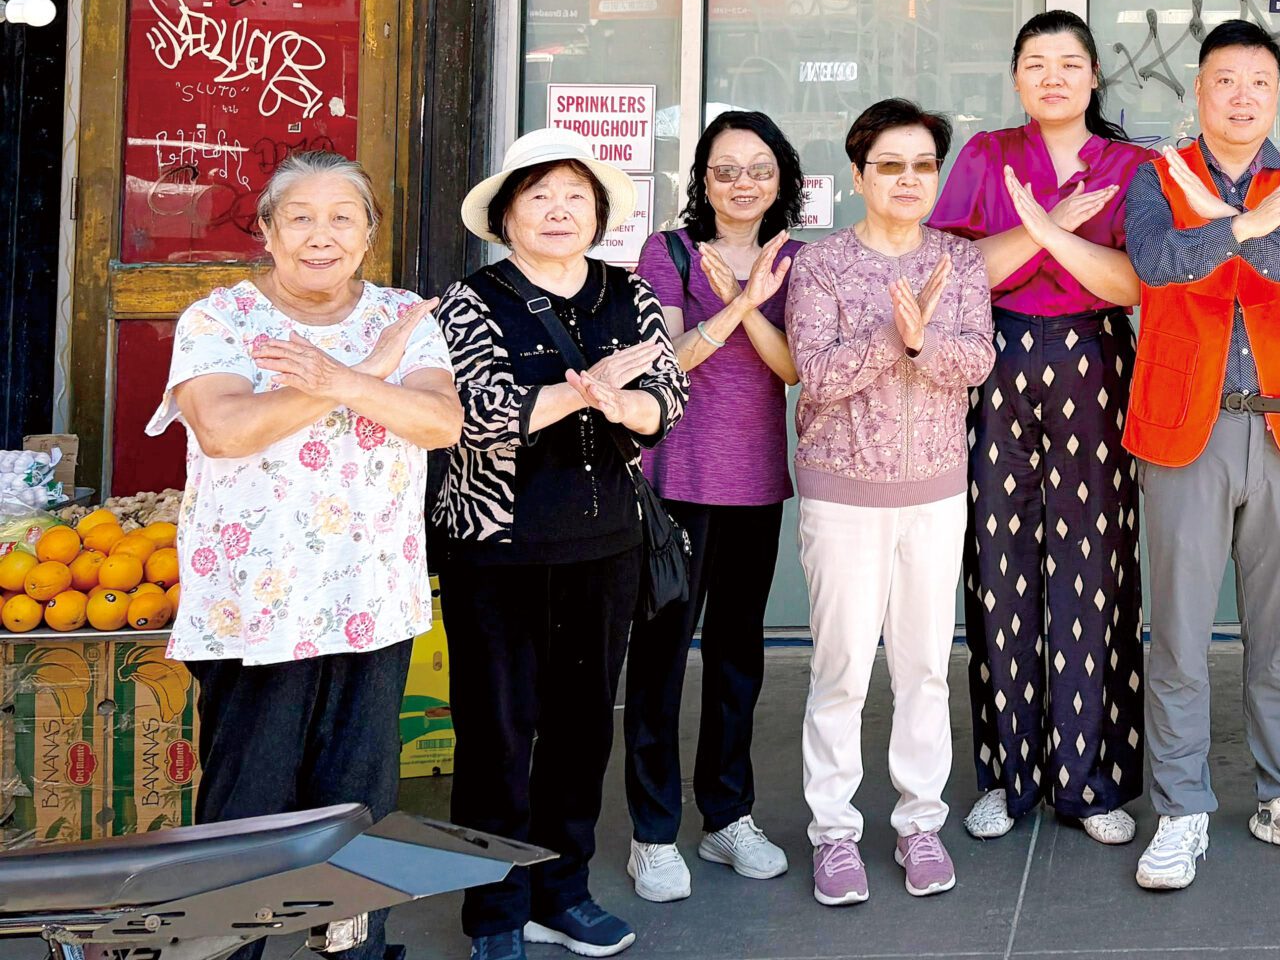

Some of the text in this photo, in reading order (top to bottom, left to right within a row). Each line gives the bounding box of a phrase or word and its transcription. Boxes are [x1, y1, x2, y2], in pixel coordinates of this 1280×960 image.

[557, 95, 646, 113] SPRINKLERS
[553, 119, 648, 137] THROUGHOUT
[592, 144, 632, 161] LDING
[41, 719, 61, 809] BANANAS
[75, 744, 85, 782] Del Monte
[141, 717, 161, 807] BANANAS
[175, 742, 185, 780] Del Monte
